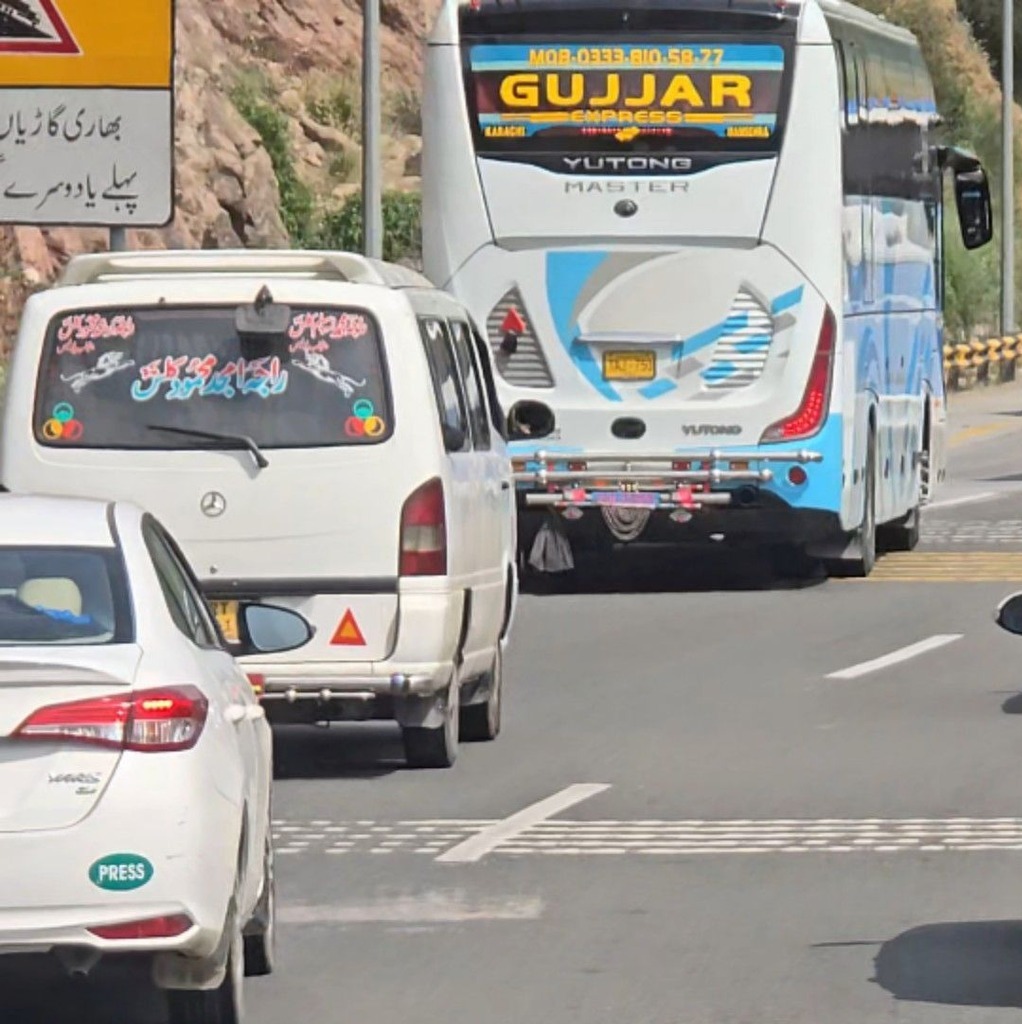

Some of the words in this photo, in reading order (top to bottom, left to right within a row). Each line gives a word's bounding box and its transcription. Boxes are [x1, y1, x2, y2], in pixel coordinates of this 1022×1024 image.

[500, 73, 752, 107] GUJJAR
[63, 108, 121, 141] بھاری
[570, 110, 682, 123] EXPRESS
[563, 157, 692, 170] YUTONG
[3, 181, 83, 210] دوسرے
[101, 162, 139, 215] پہلے
[564, 181, 690, 193] MASTER
[98, 863, 145, 882] PRESS
